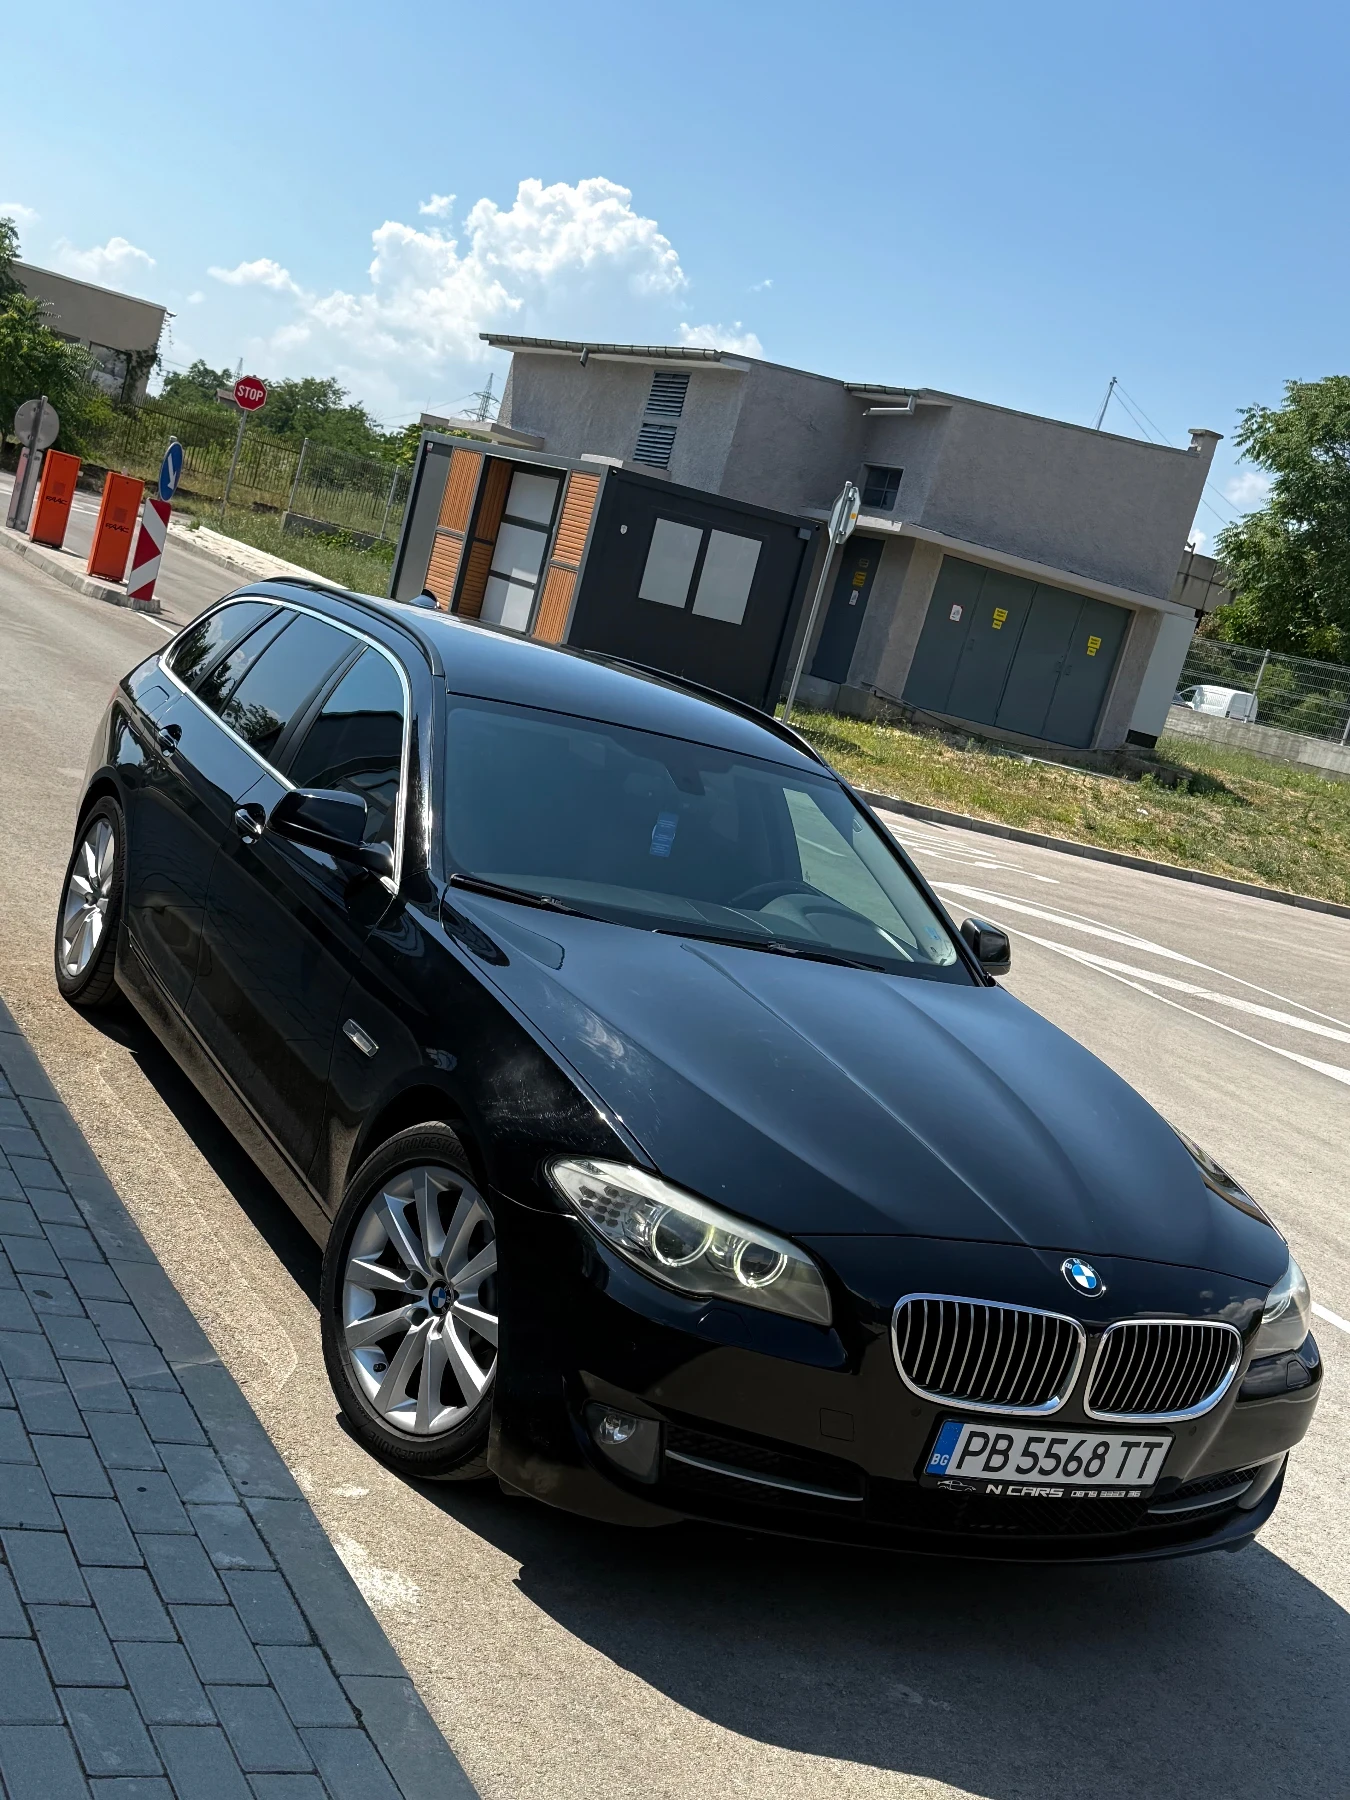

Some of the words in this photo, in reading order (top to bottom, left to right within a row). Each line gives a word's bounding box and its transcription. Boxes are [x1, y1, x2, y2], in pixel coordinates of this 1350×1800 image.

[237, 385, 264, 401] STOP
[105, 523, 129, 533] FAAC
[930, 1453, 950, 1466] BG
[956, 1431, 1014, 1473] PB
[1015, 1436, 1110, 1478] 5568
[1115, 1441, 1164, 1480] TT
[985, 1484, 1003, 1495] N
[1006, 1485, 1065, 1498] CARS
